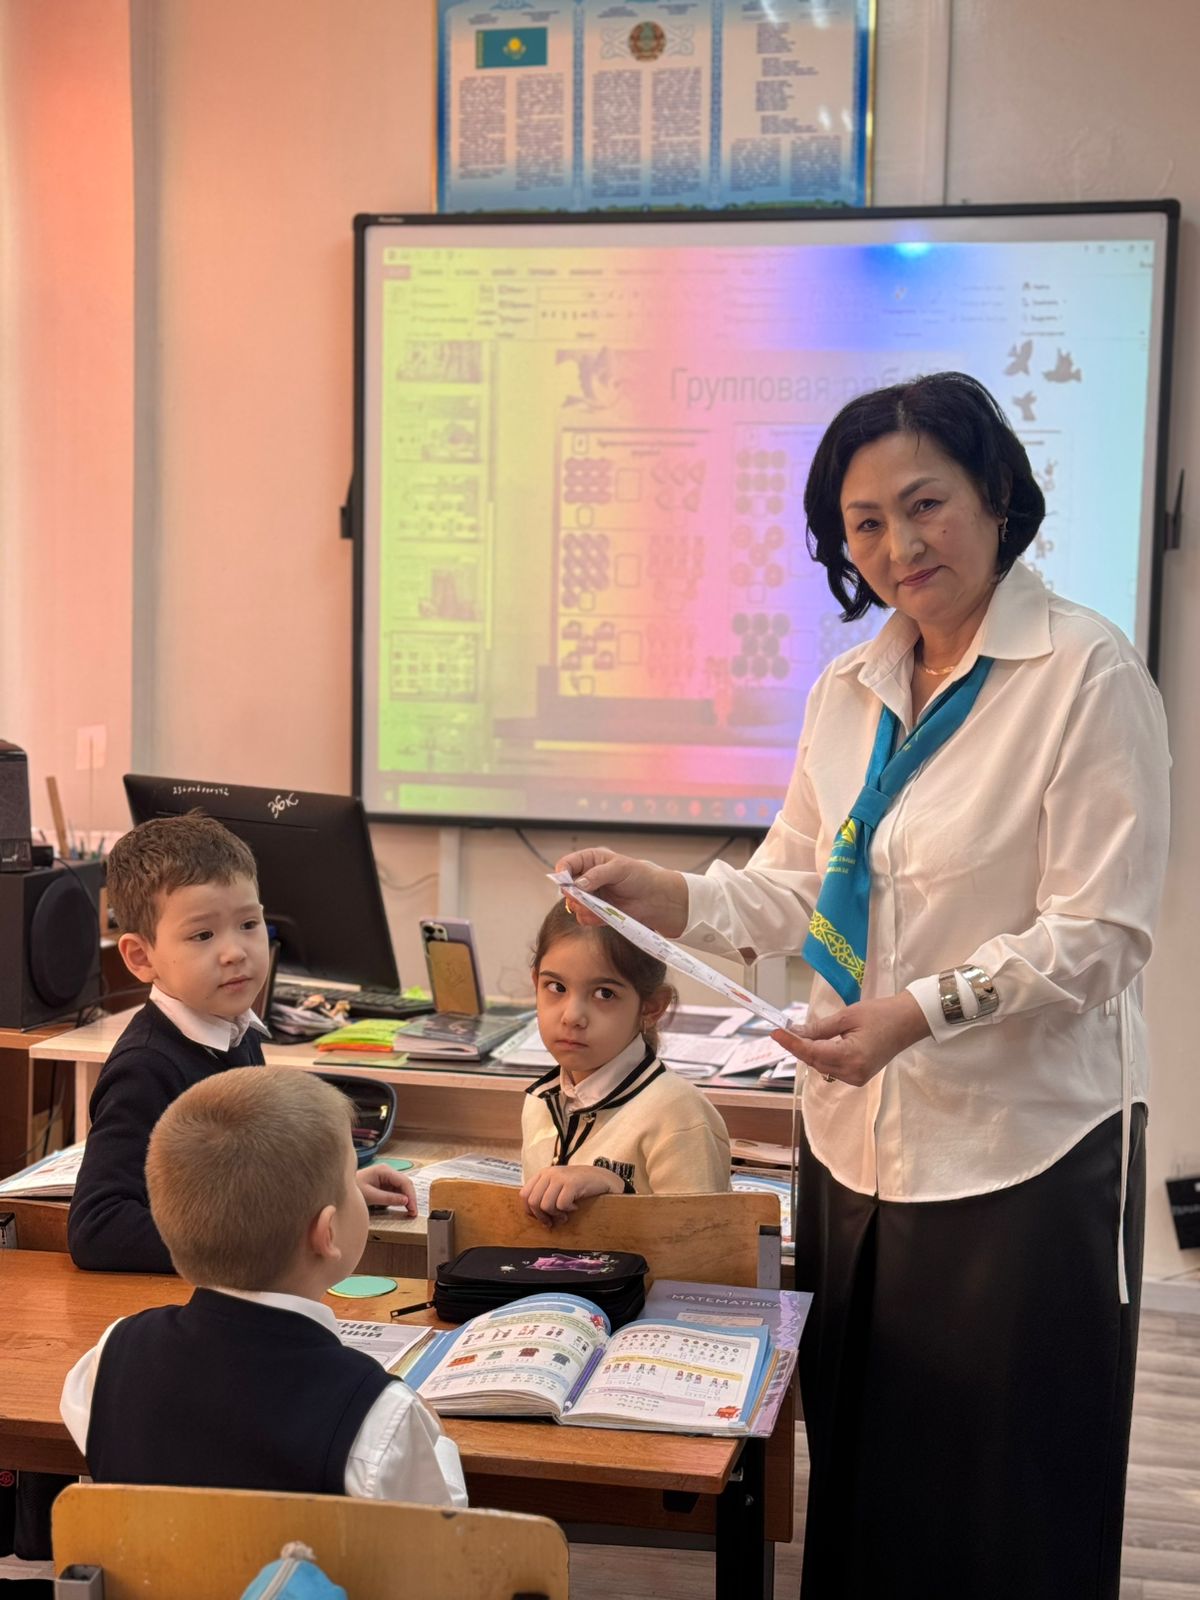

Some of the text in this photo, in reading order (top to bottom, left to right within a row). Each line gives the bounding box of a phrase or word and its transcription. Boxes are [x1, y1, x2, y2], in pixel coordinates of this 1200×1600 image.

[671, 367, 900, 411] Групповая раб
[671, 1293, 783, 1309] МАТЕМАТИКА
